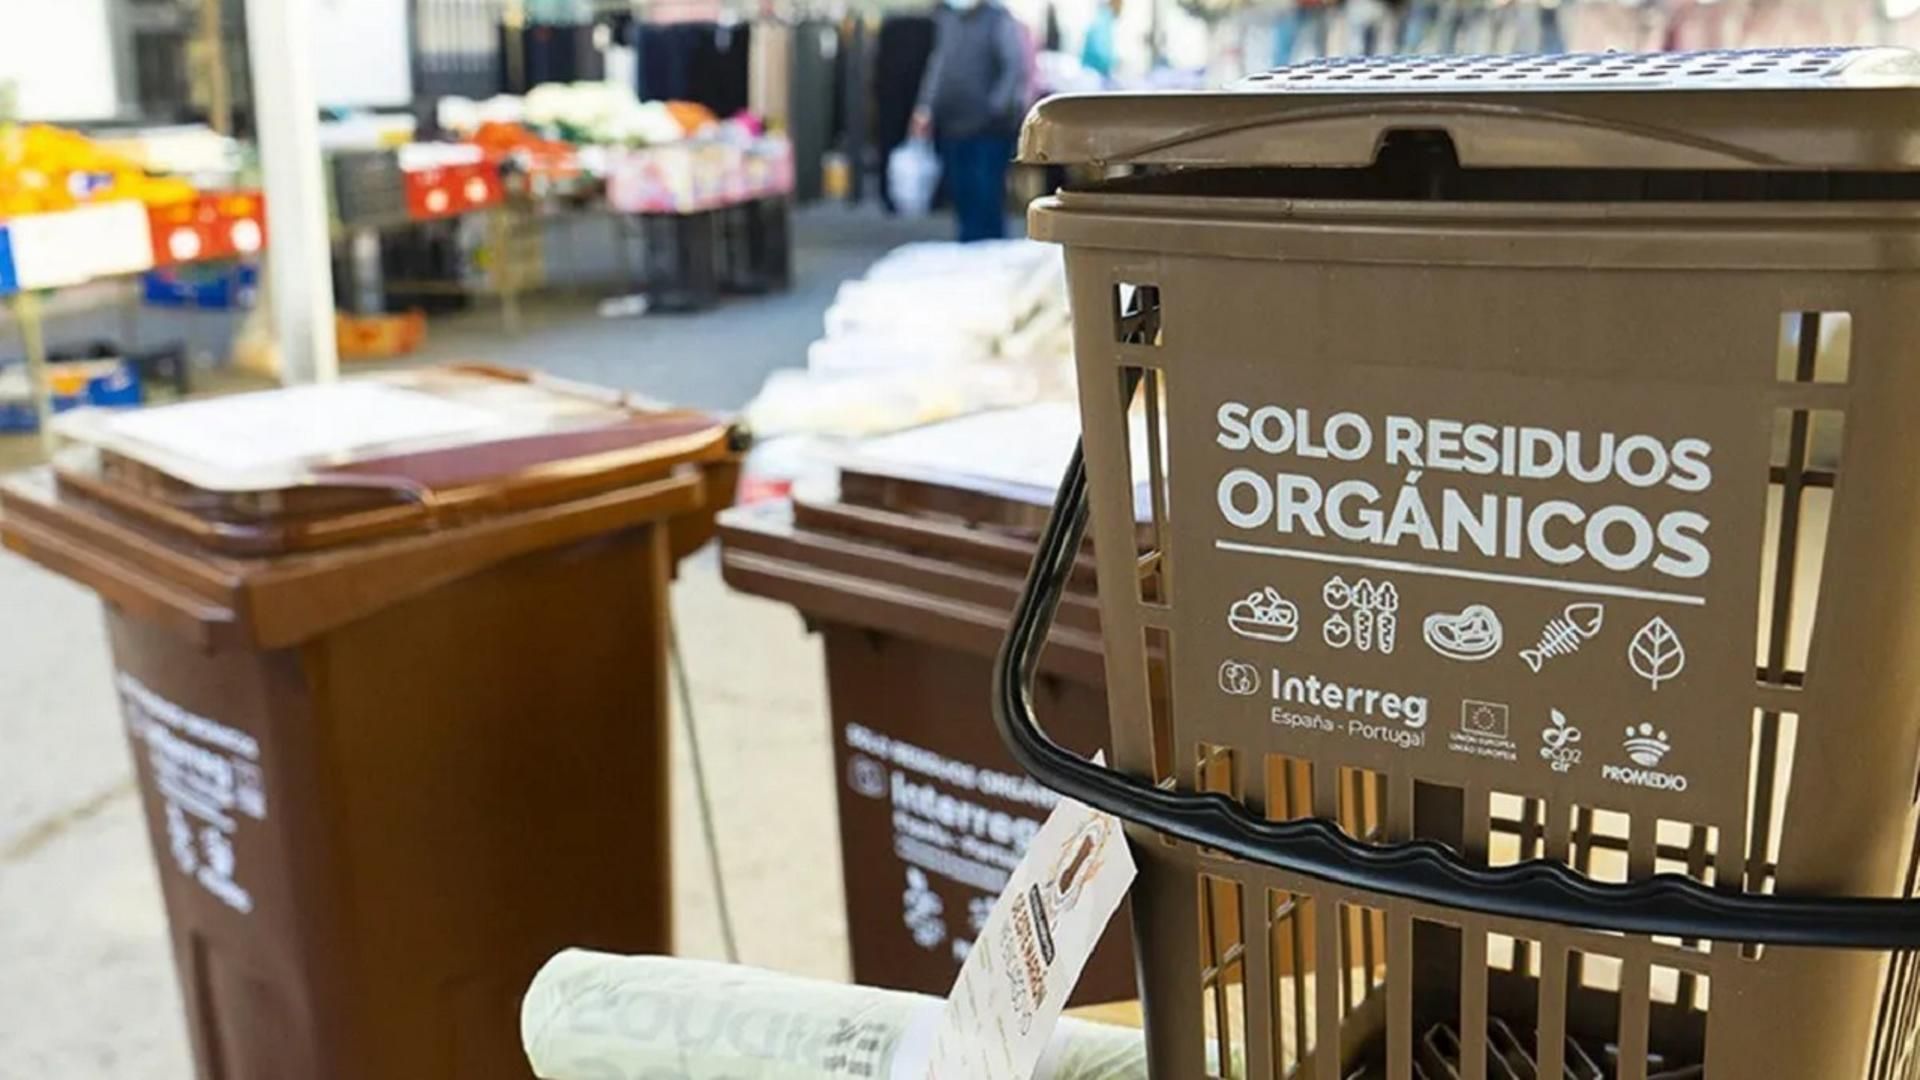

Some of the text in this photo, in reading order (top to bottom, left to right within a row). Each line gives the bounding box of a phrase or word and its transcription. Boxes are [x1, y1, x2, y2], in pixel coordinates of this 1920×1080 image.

[1217, 402, 1712, 492] SOLO RESIDUOS
[1217, 469, 1711, 578] ORGÁNICOS
[1271, 706, 1334, 732] España
[1348, 720, 1425, 748] Portugal
[1272, 668, 1427, 728] Interreg
[1602, 764, 1688, 792] PROMEDIO
